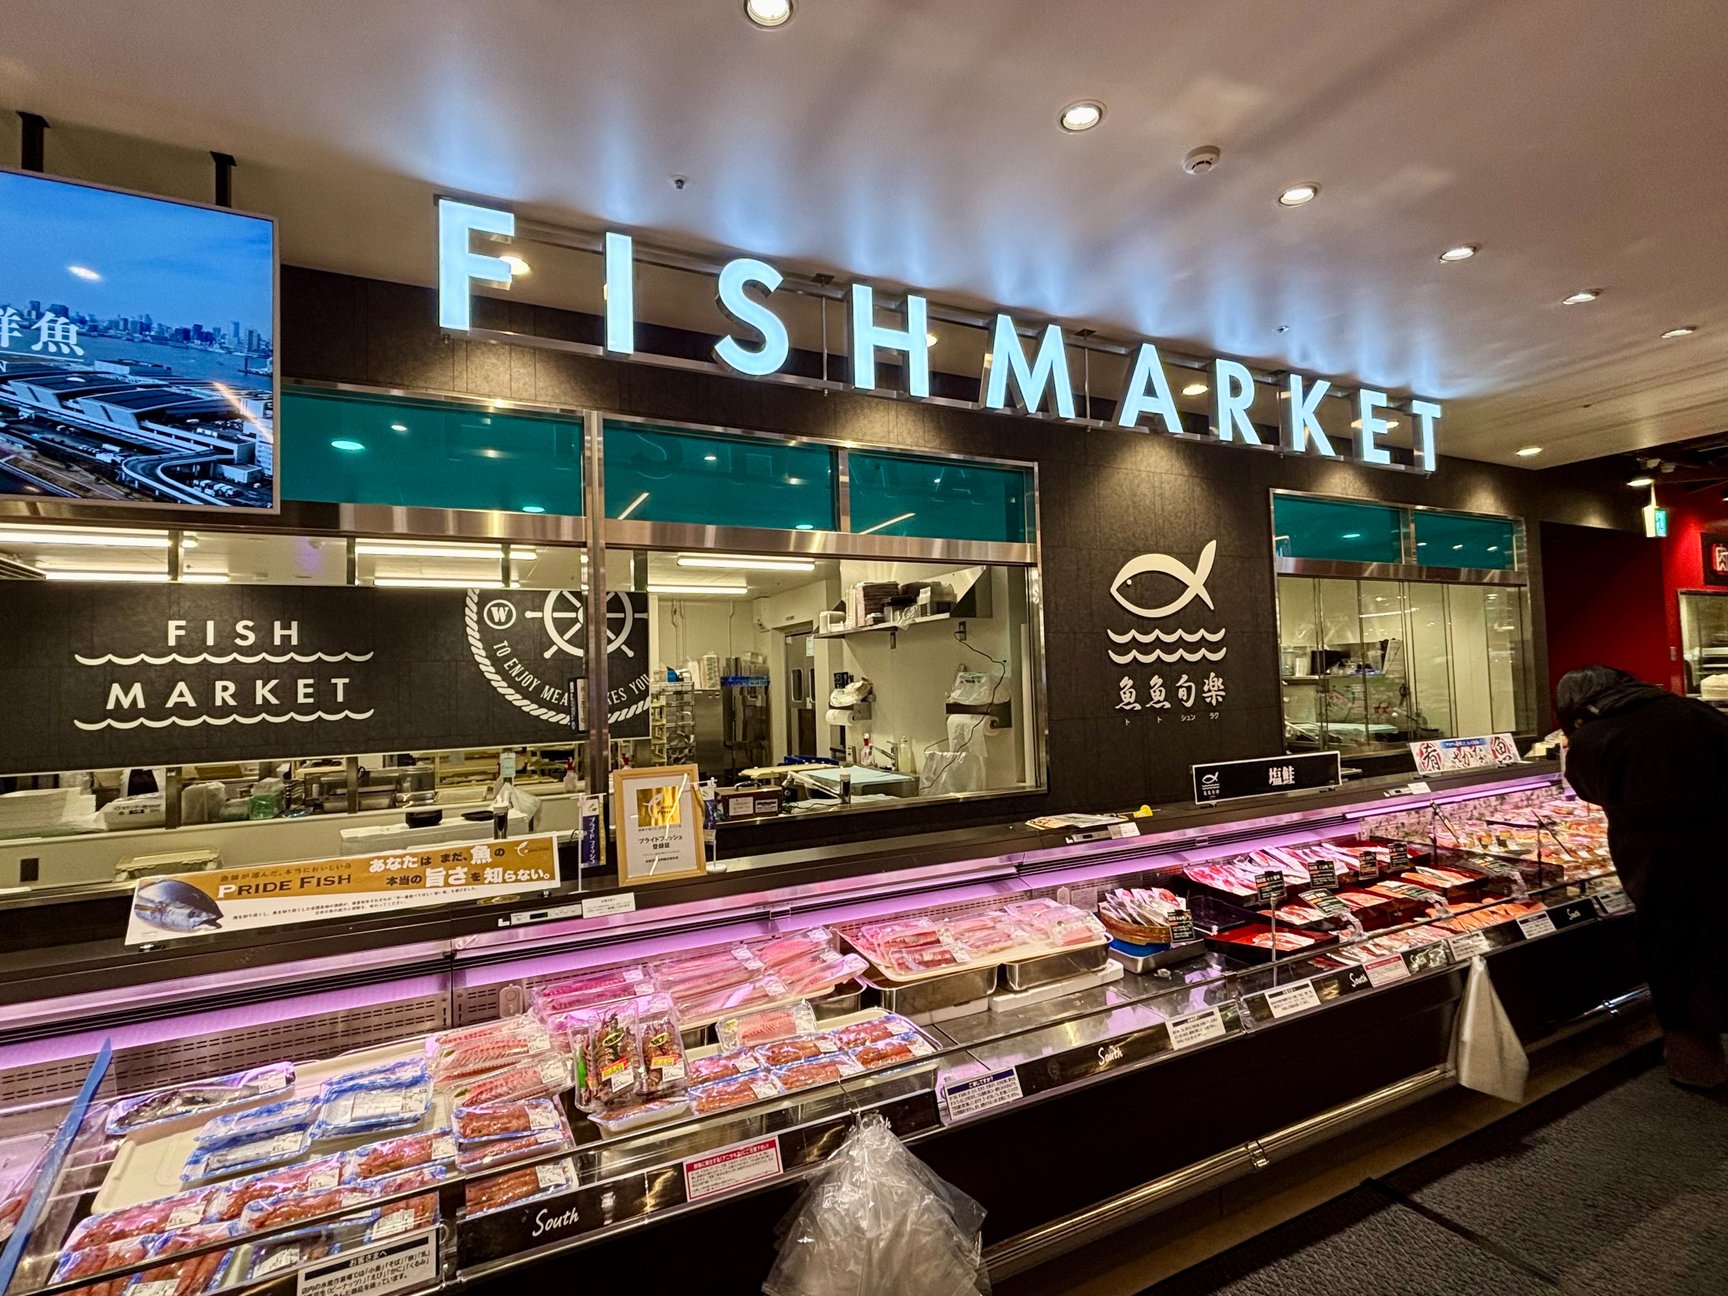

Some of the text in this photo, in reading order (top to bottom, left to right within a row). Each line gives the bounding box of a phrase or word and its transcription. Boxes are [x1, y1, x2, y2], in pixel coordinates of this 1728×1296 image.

[490, 607, 509, 622] W
[167, 620, 298, 646] FISH
[493, 640, 511, 657] TO
[503, 658, 541, 692] ENJOY
[106, 678, 350, 710] MARKET
[1115, 672, 1226, 711] 魚魚旬楽
[1269, 765, 1295, 785] 塩鮭
[368, 854, 432, 873] あなたは
[385, 866, 551, 888] 本当の旨さを知らない。
[532, 1206, 580, 1237] South
